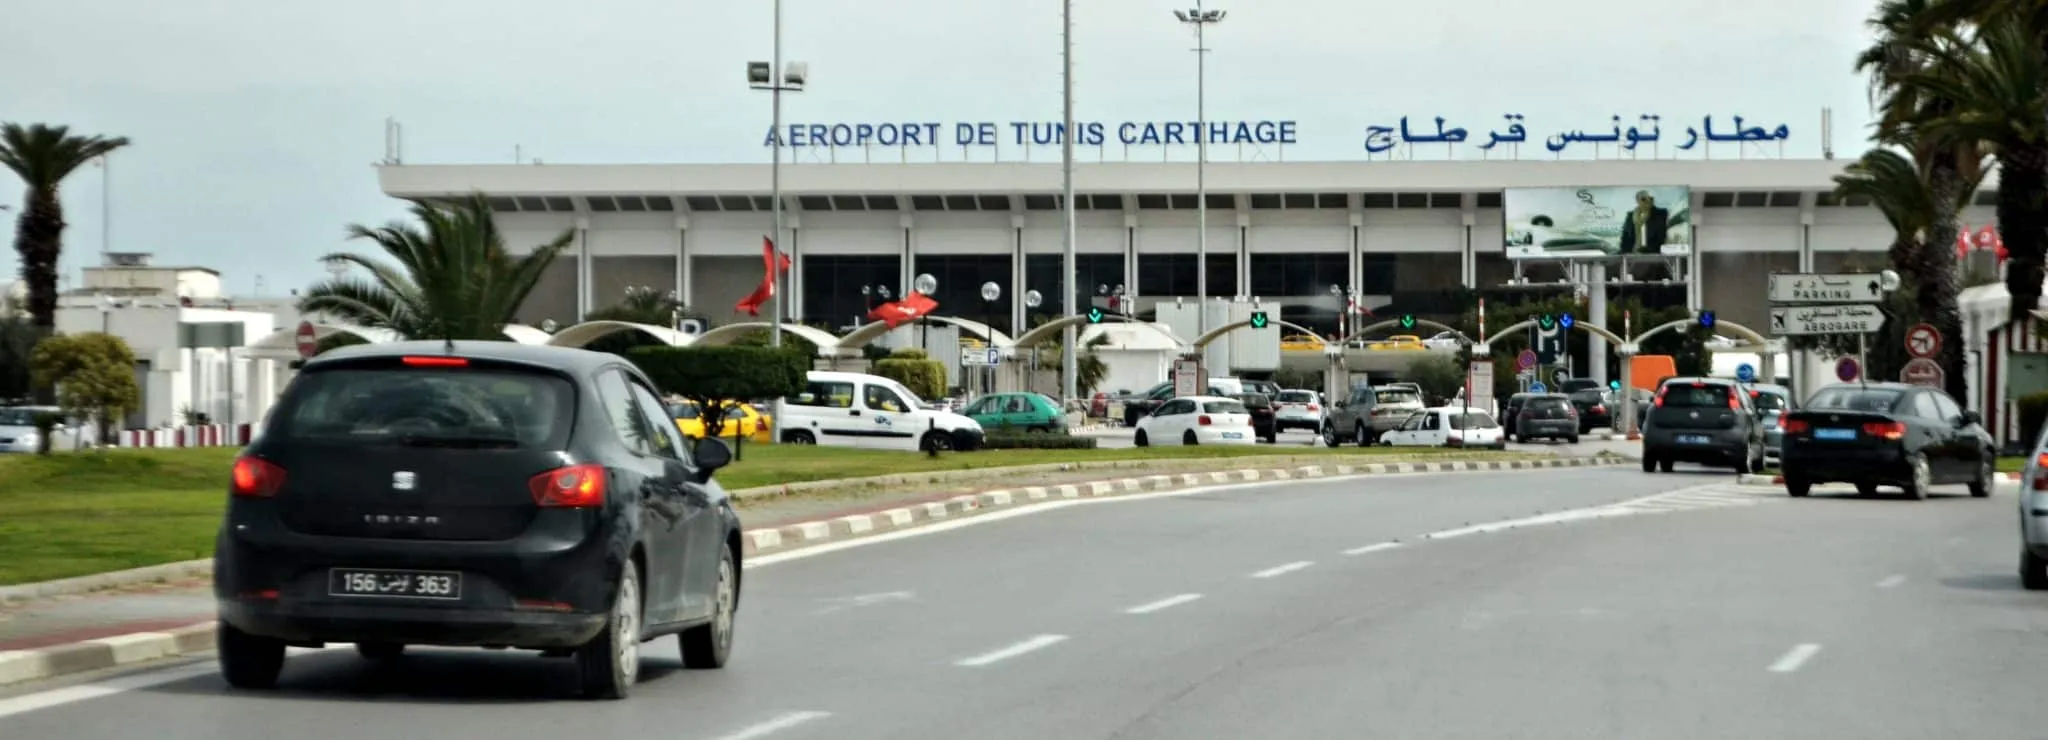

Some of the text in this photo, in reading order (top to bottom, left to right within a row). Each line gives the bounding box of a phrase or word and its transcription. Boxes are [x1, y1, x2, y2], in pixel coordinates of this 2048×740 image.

[763, 120, 1297, 147] AEROPORT DE TUNIS CARTHAGE
[1546, 114, 1660, 151] تونس
[1675, 114, 1789, 150] مطار
[1793, 290, 1851, 299] PARKING
[344, 573, 377, 592] 156
[415, 575, 450, 594] 363
